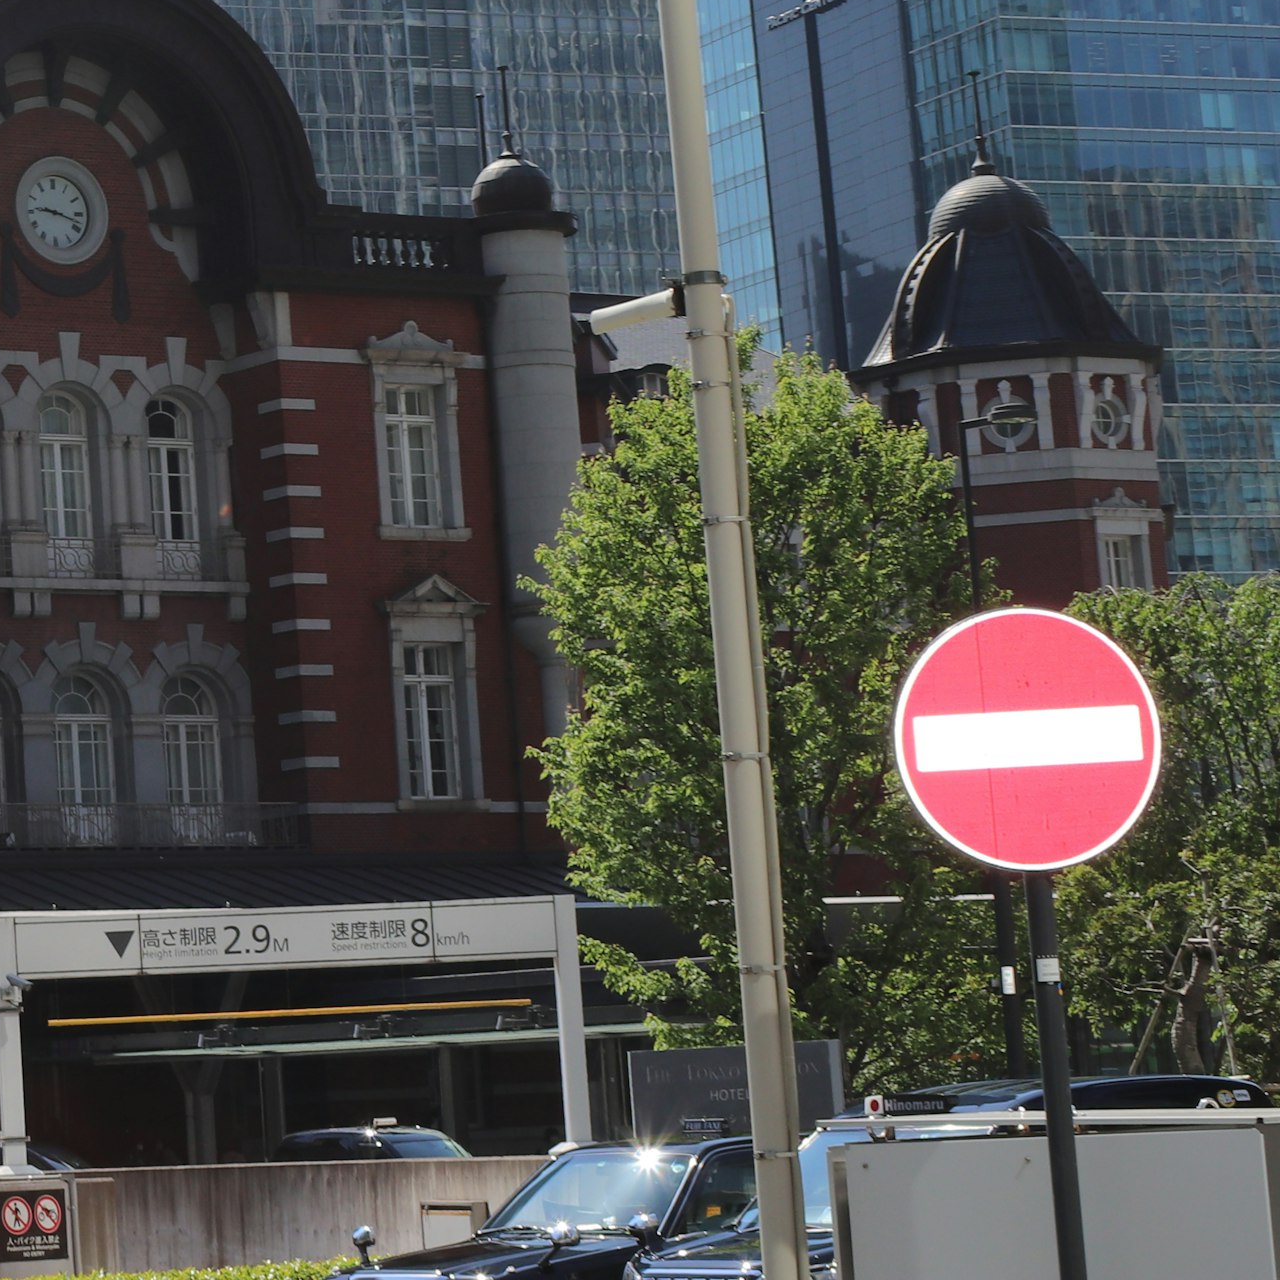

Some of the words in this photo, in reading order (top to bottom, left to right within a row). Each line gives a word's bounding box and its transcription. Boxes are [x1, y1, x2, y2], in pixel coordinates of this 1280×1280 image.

[141, 927, 217, 948] 高さ制限
[331, 919, 407, 941] 速度制限
[411, 918, 430, 947] 8
[436, 931, 470, 946] km/h
[331, 942, 358, 952] Speed
[360, 940, 407, 951] restrictions
[142, 949, 172, 960] Height
[175, 948, 218, 957] limitation
[710, 1088, 750, 1101] HOTEL
[884, 1099, 944, 1111] Hinomaru
